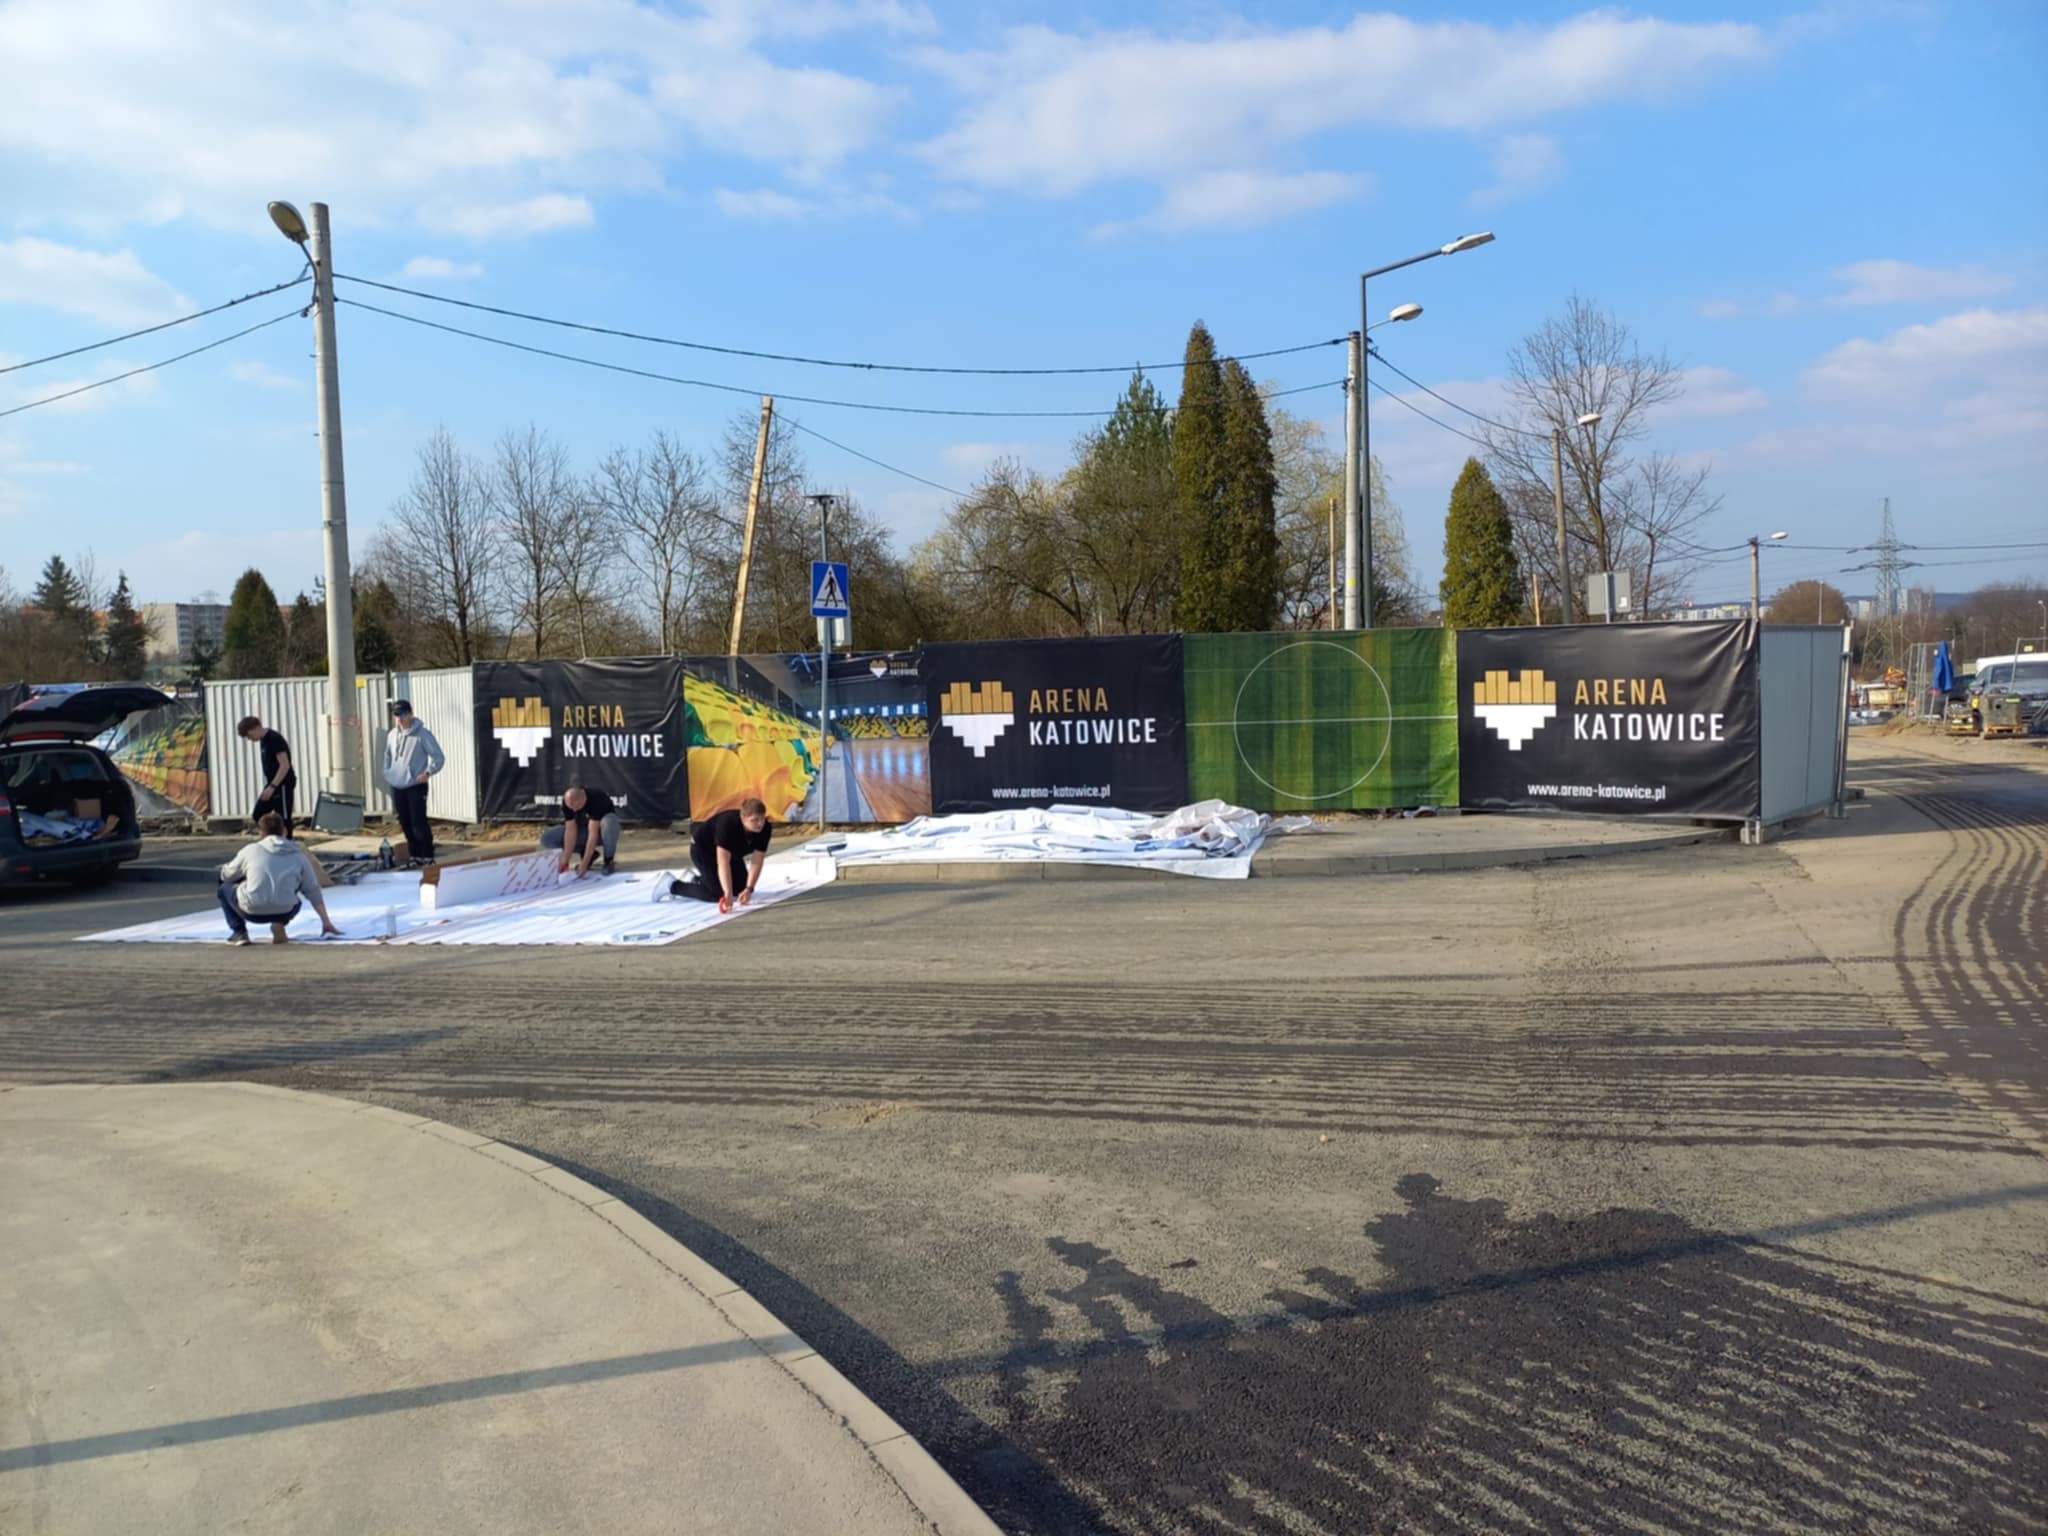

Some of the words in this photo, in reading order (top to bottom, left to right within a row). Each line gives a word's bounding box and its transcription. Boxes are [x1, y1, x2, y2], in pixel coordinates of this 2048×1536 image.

[1029, 688, 1108, 713] ARENA
[1574, 678, 1667, 706] ARENA
[562, 704, 625, 728] ARENA
[1573, 712, 1725, 743] KATOWICE
[1029, 717, 1158, 747] KATOWICE
[563, 733, 665, 759] KATOWICE
[992, 783, 1111, 799] www.arena-katowice.pl
[1527, 783, 1666, 802] www.arena-katowice.pl
